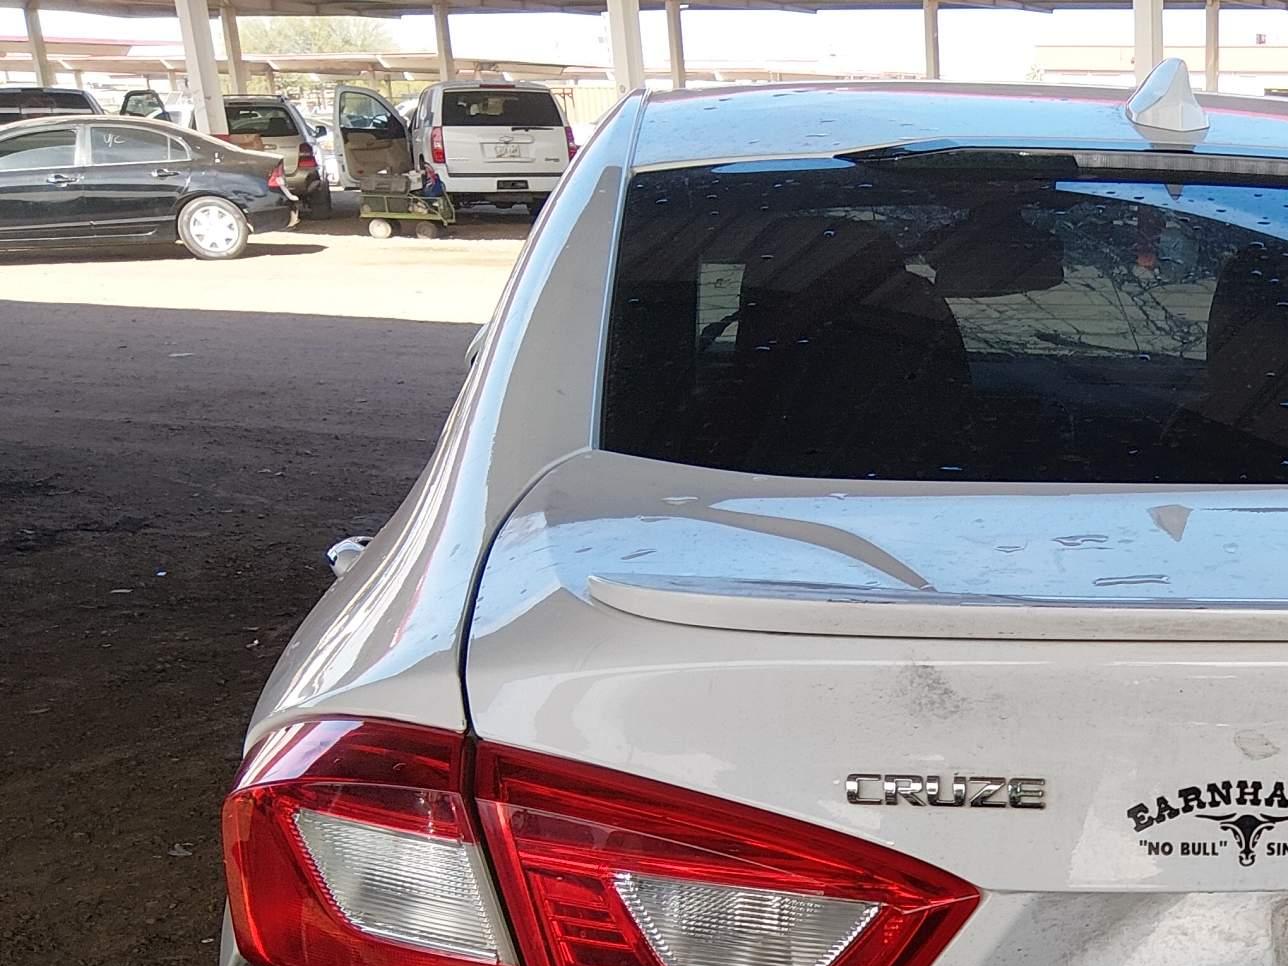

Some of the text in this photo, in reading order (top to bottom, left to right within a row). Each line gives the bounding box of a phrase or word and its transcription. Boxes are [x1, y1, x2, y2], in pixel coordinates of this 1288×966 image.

[846, 773, 1046, 809] CRUZE
[1139, 840, 1228, 856] "NO BULL"
